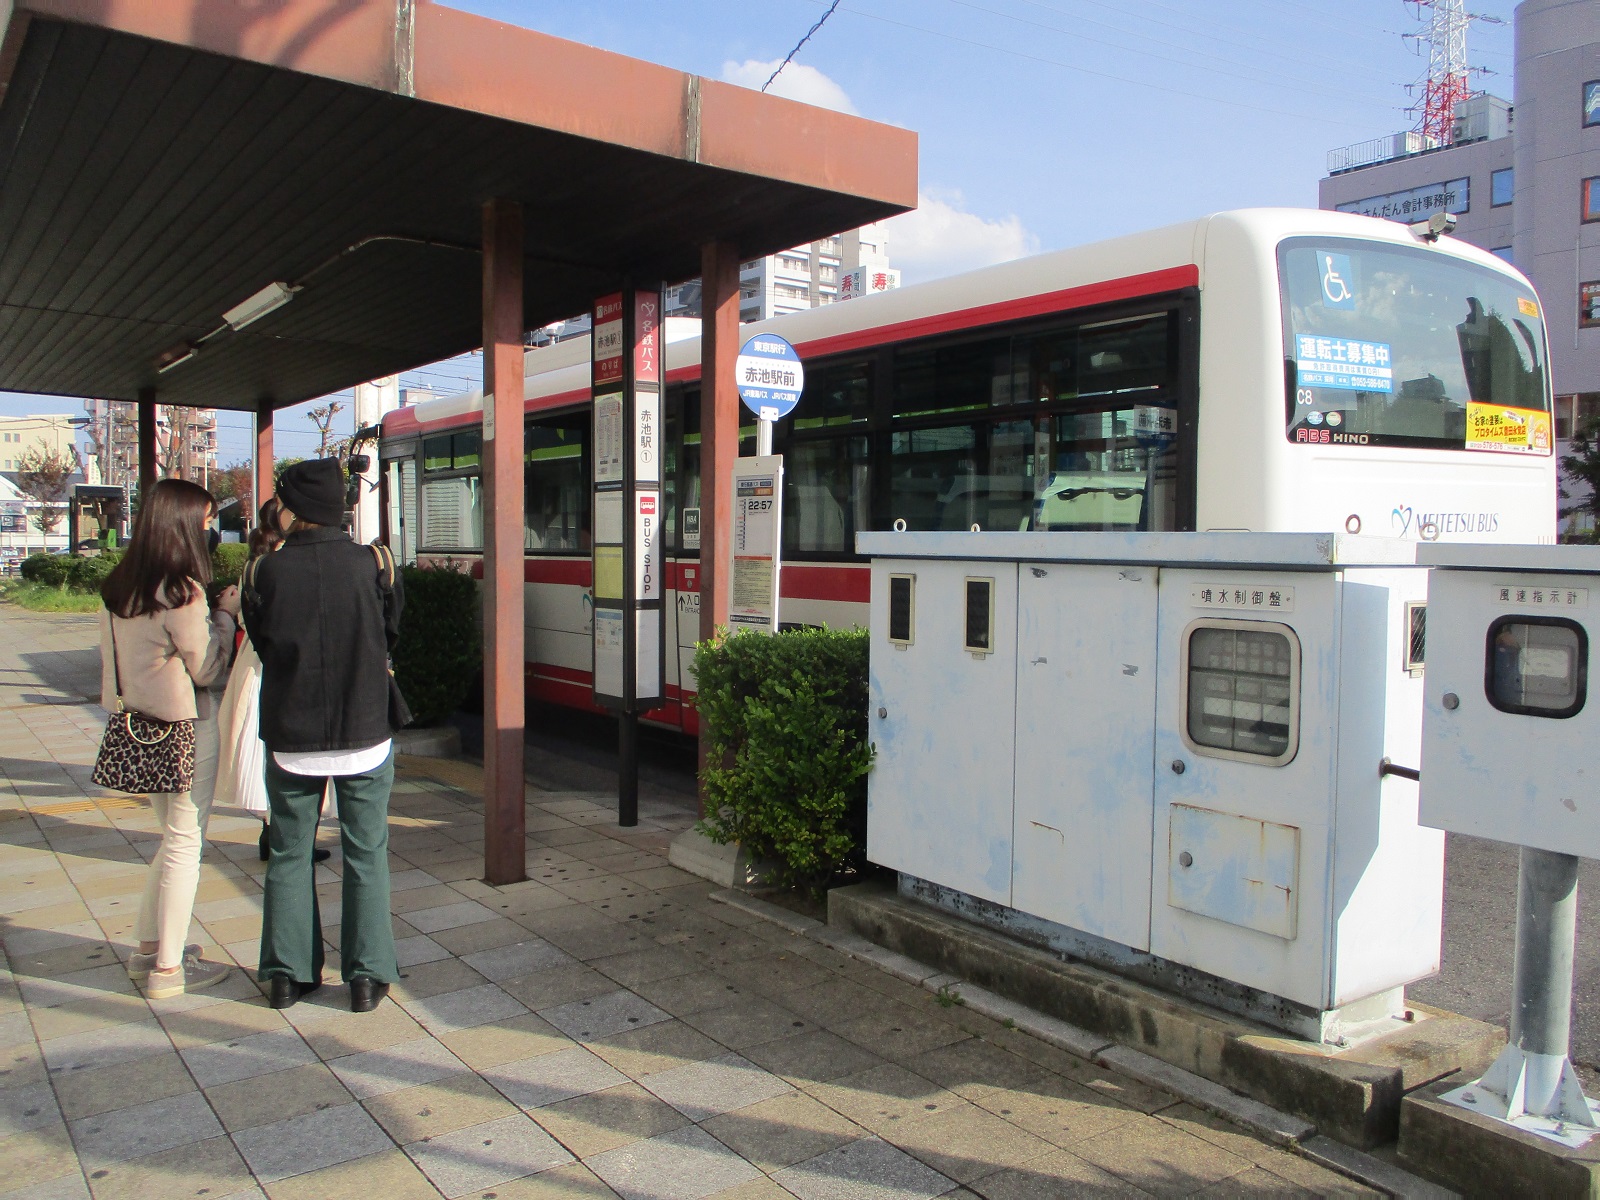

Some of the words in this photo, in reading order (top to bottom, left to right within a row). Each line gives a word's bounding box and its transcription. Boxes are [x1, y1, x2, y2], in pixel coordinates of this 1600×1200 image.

[642, 320, 653, 371] 名鉄バス
[1300, 337, 1389, 366] 運転士募集中
[745, 367, 795, 386] 赤池駅前
[1297, 389, 1312, 405] C8
[1297, 428, 1329, 443] ABS
[1333, 433, 1369, 444] HINO
[748, 500, 773, 510] 22:57
[1477, 512, 1499, 533] BUS
[643, 517, 651, 548] BUS
[643, 554, 652, 594] STOP
[686, 594, 700, 605] 入口
[1201, 588, 1281, 607] 噴水制御盤
[1500, 588, 1578, 605] 風速指示計
[685, 606, 700, 614] ENTRANC
